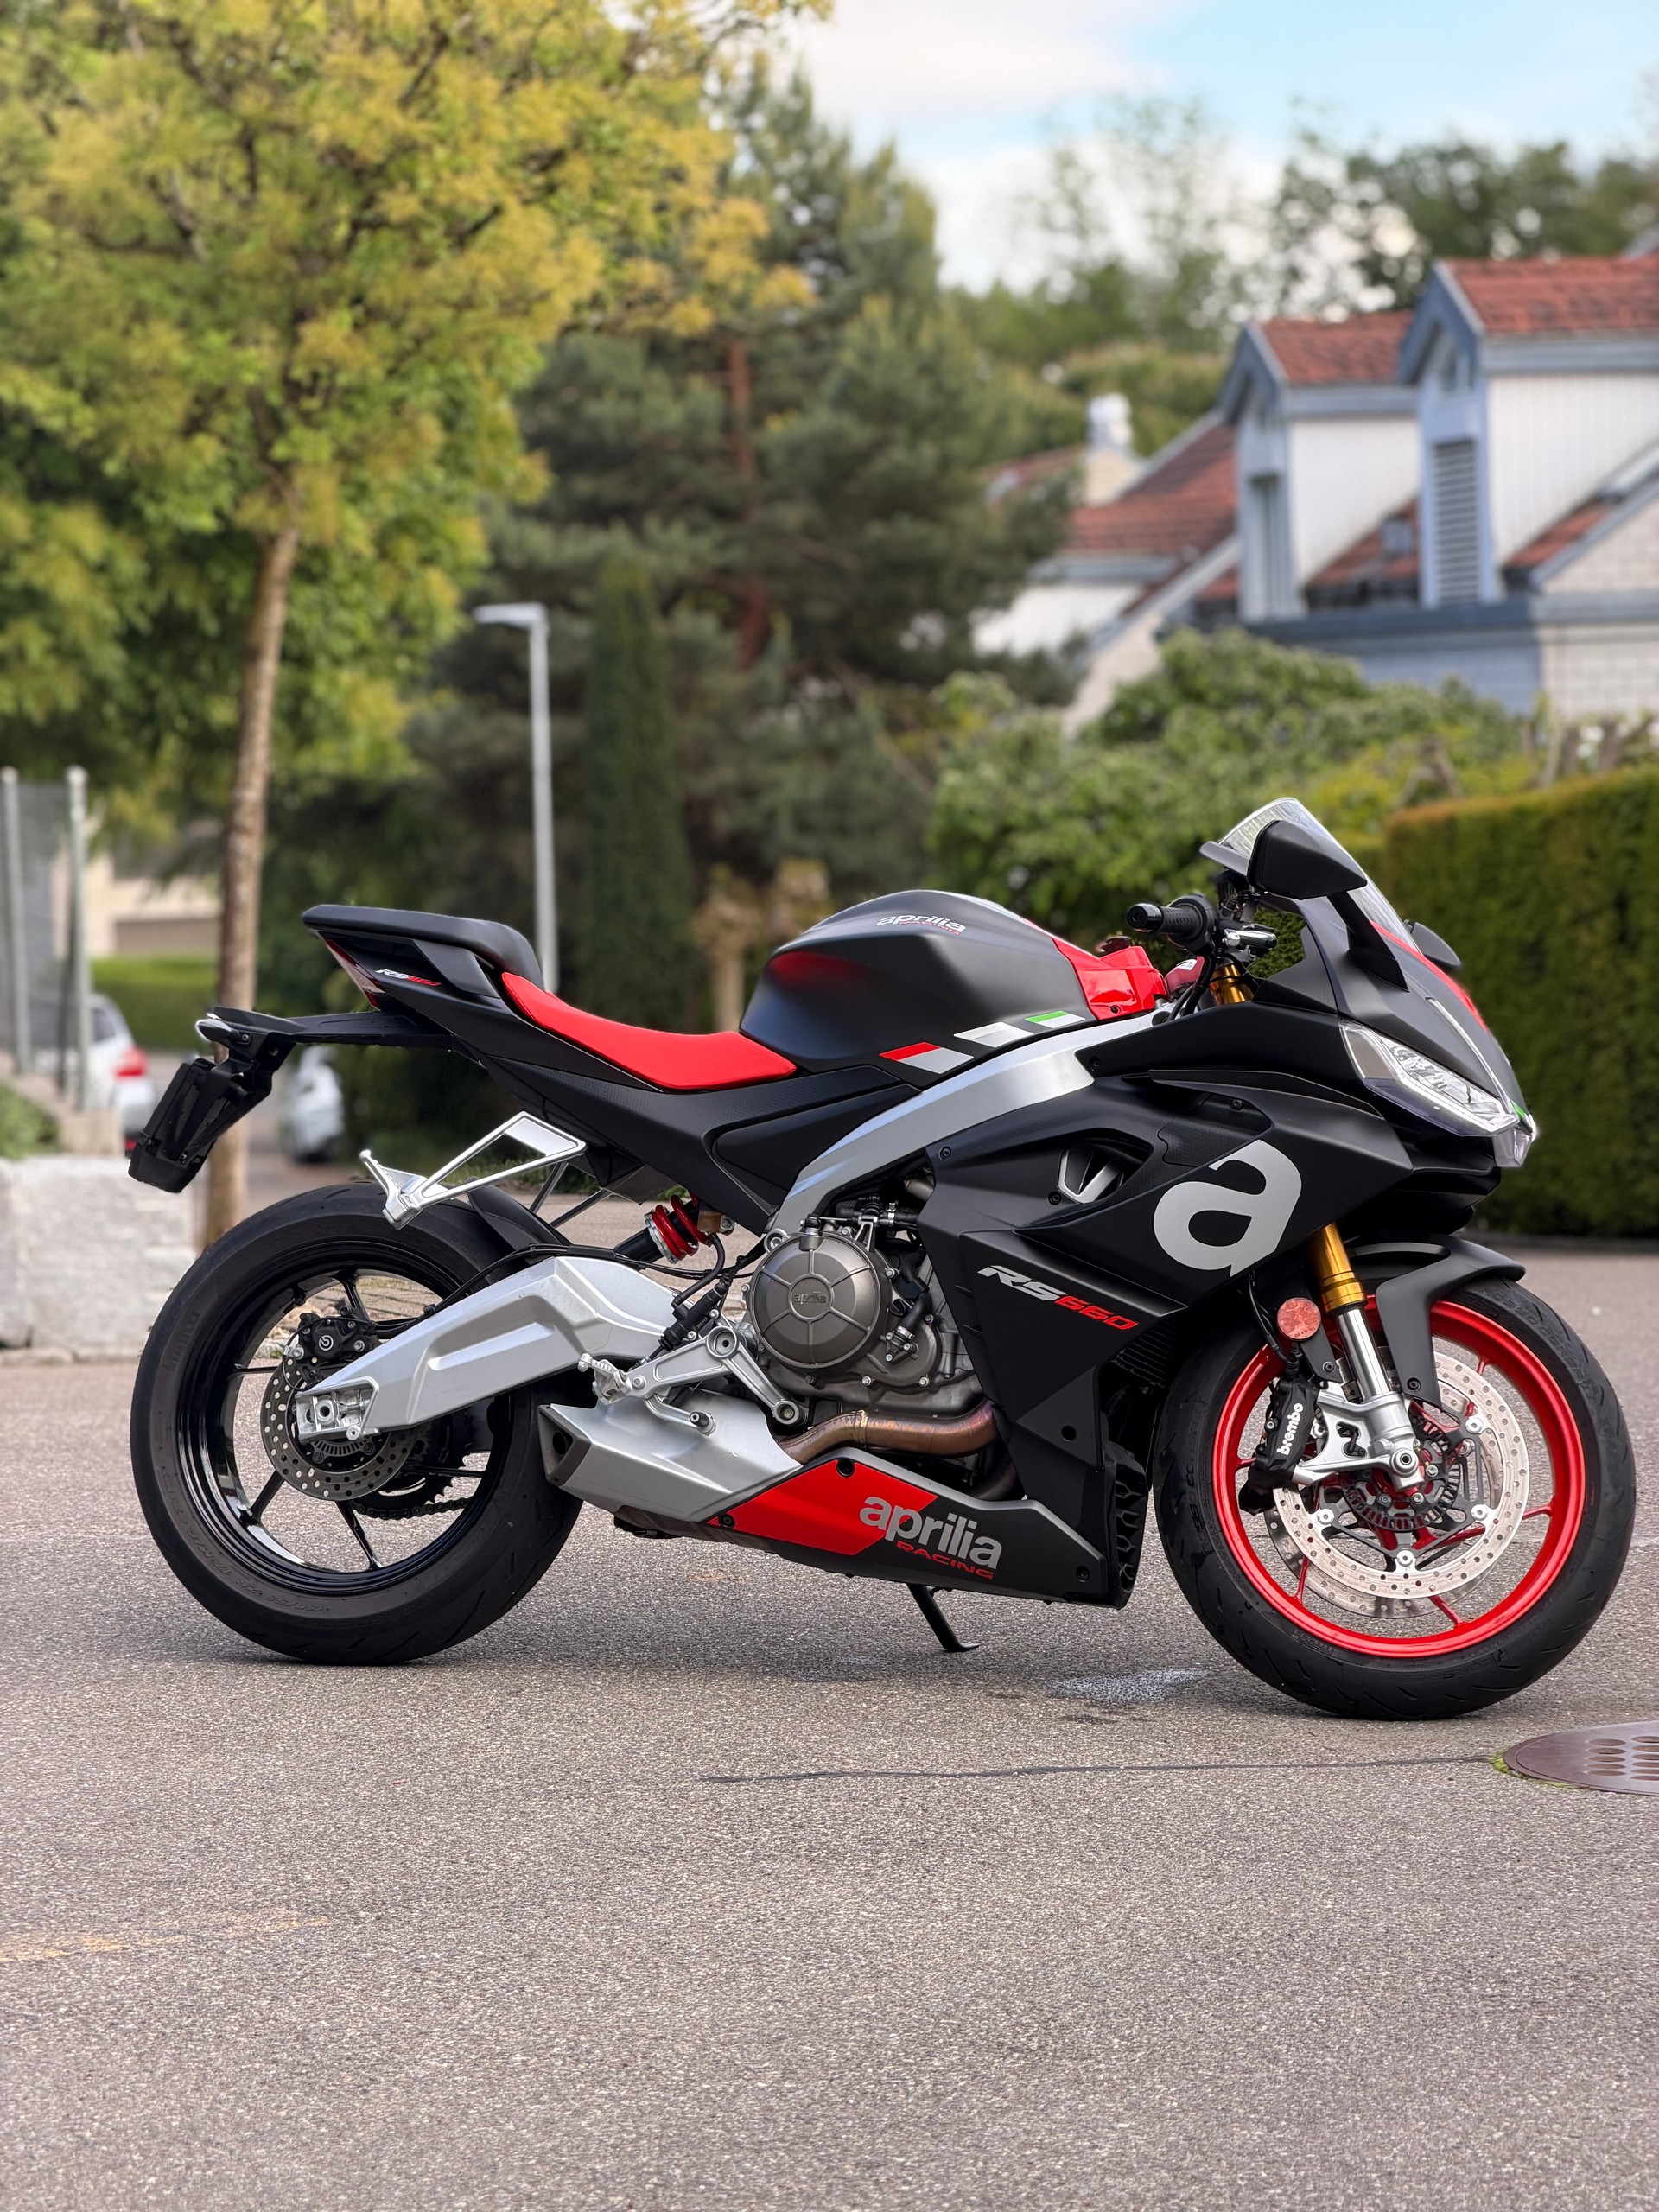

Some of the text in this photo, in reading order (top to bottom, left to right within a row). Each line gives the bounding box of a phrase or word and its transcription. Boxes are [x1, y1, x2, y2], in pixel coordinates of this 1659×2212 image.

[876, 914, 966, 932] aprilia
[794, 1291, 827, 1305] aprilia
[977, 1265, 1139, 1330] RS660
[1276, 1402, 1304, 1456] brembo
[860, 1496, 1002, 1570] aprilia
[896, 1541, 995, 1580] RACING
